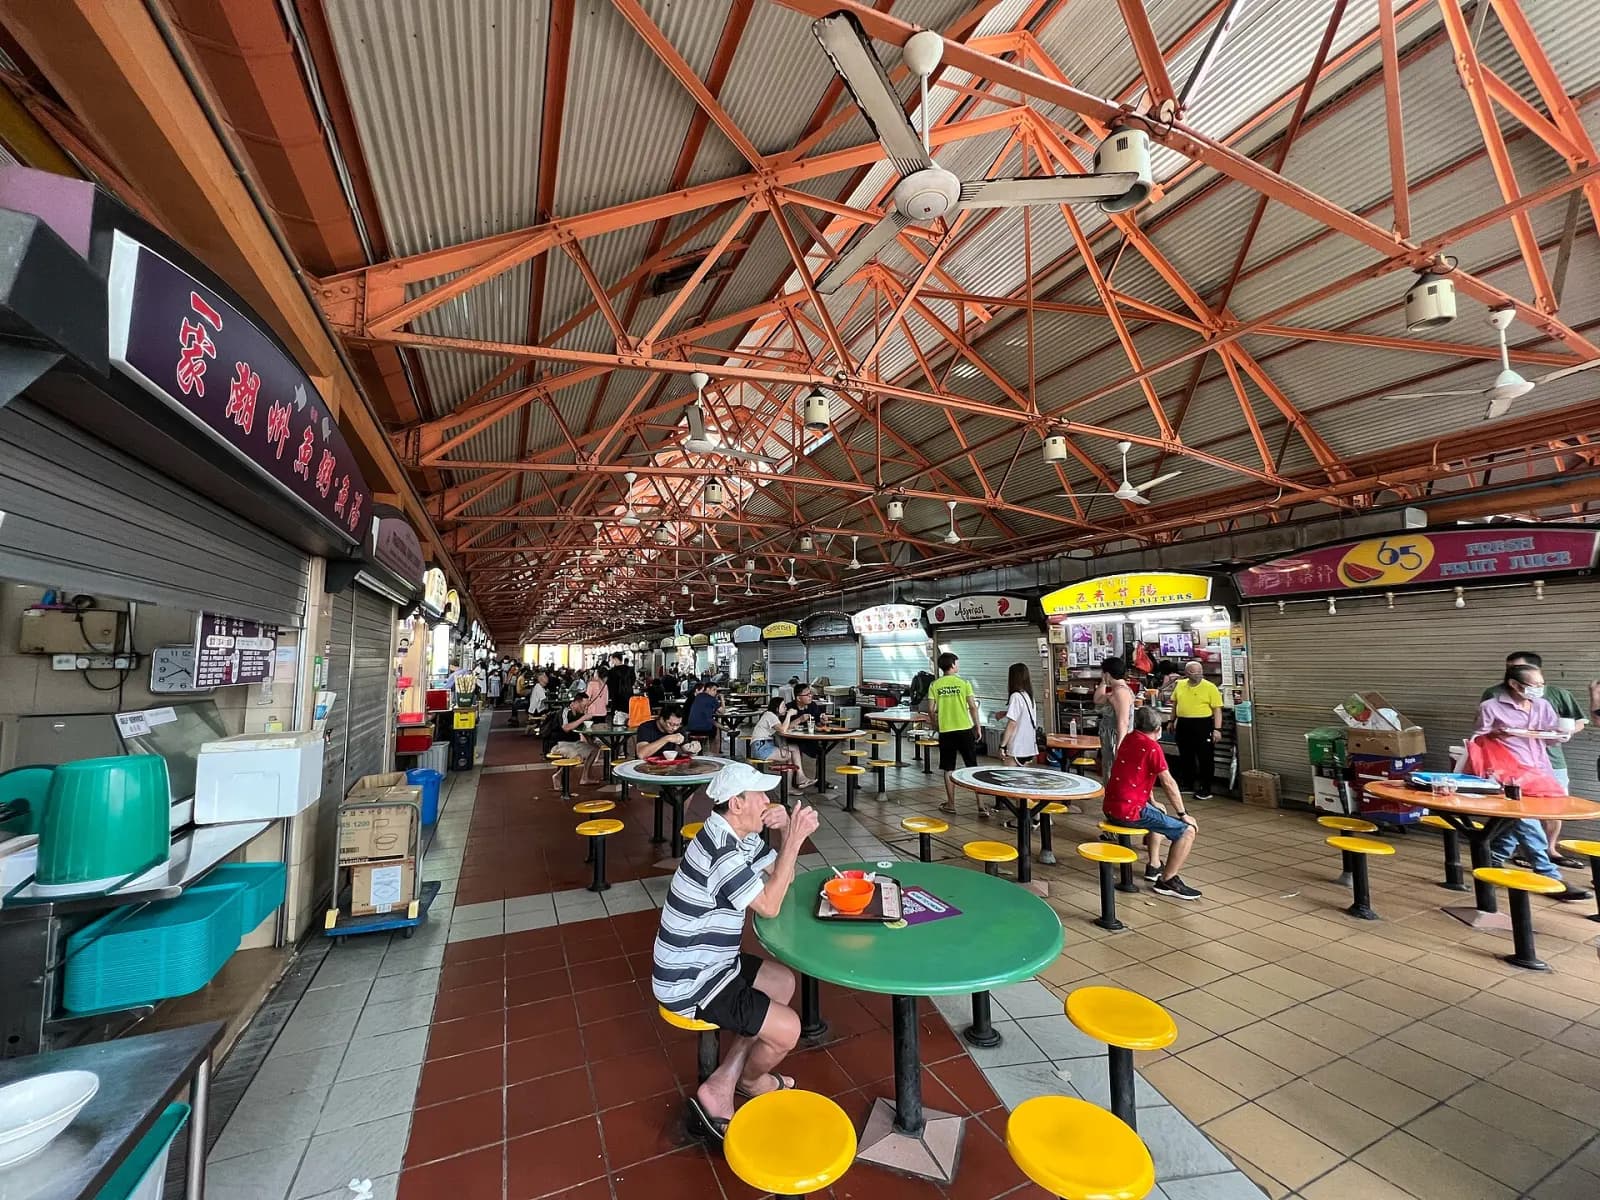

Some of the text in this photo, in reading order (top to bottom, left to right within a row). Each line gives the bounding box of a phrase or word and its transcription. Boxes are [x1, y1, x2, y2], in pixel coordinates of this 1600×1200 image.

[1377, 540, 1423, 570] 65
[1465, 536, 1535, 556] FRESH
[1440, 551, 1572, 576] FRUIT JUICE
[1053, 592, 1193, 612] CHINA STREET FRITTERS
